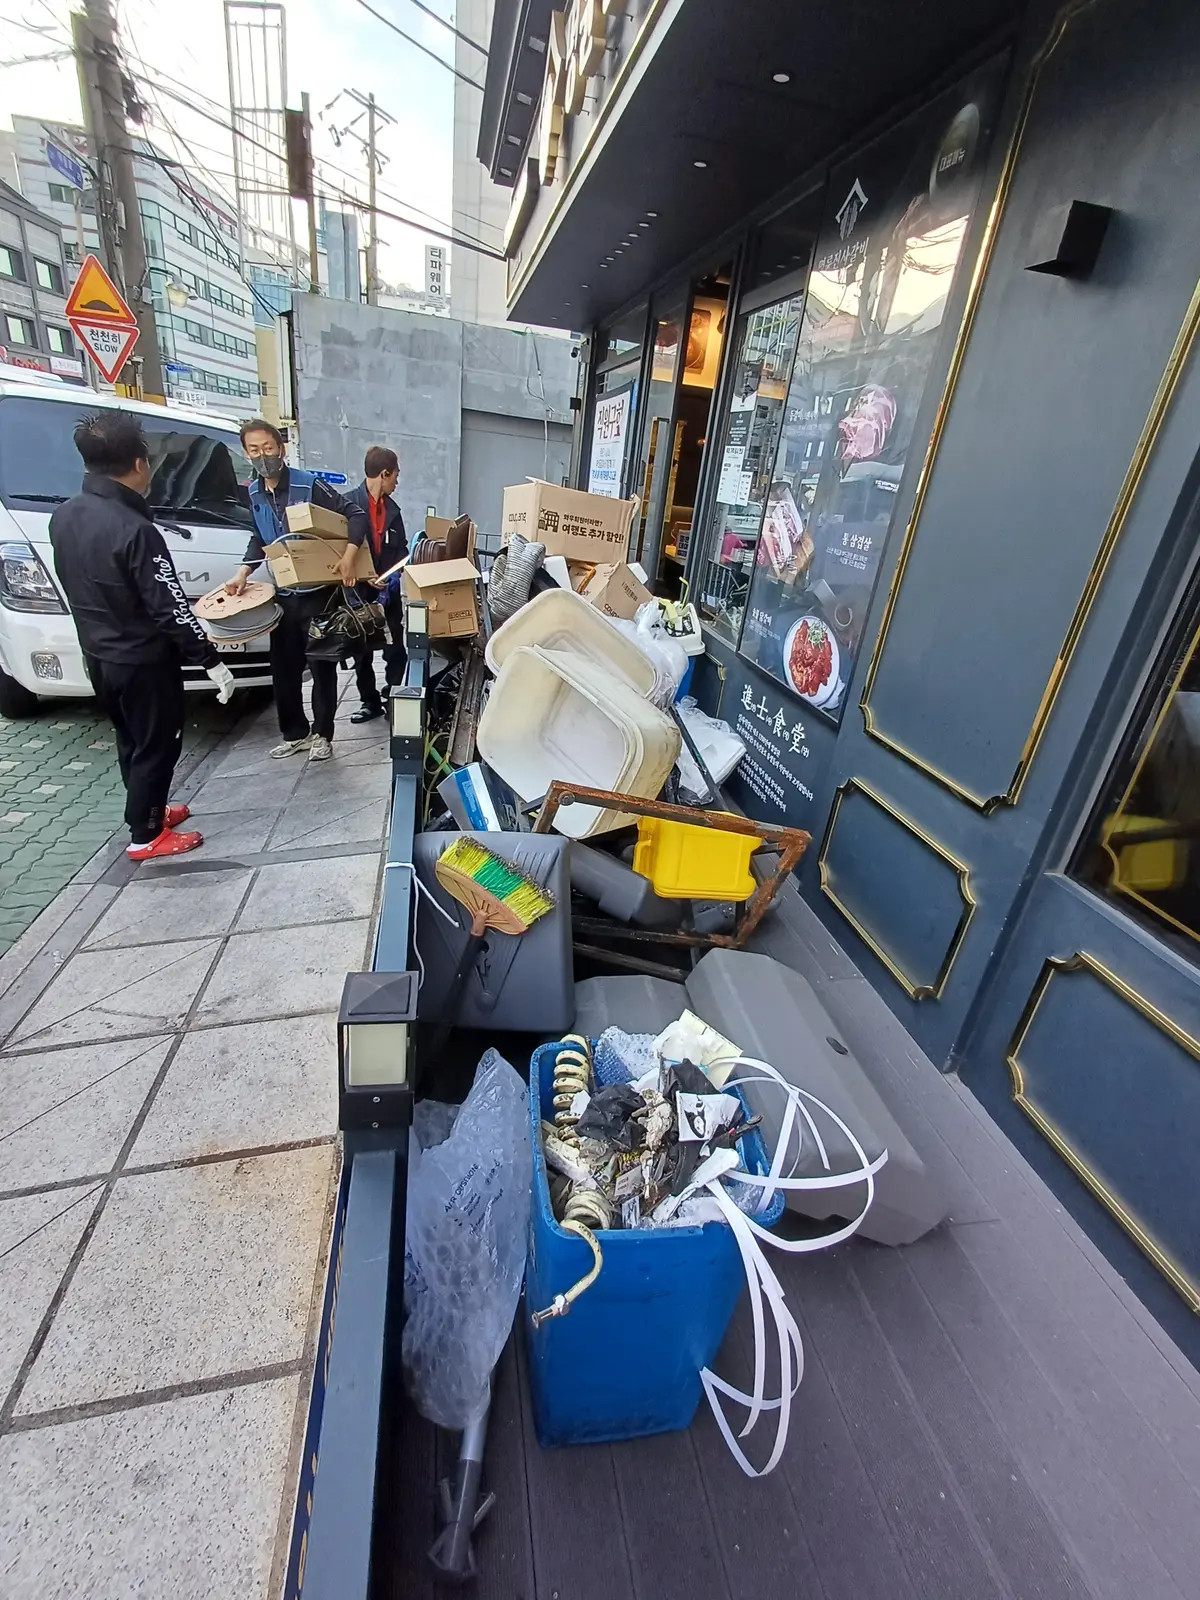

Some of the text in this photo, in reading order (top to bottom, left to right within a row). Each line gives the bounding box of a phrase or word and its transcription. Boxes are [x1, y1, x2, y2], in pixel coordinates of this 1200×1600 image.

[429, 247, 443, 296] 타파웨어
[89, 328, 121, 345] 천천히
[93, 342, 119, 354] SLOW
[563, 514, 603, 528] 와우회원이라면?
[561, 524, 625, 544] 여행도 추가 할인!
